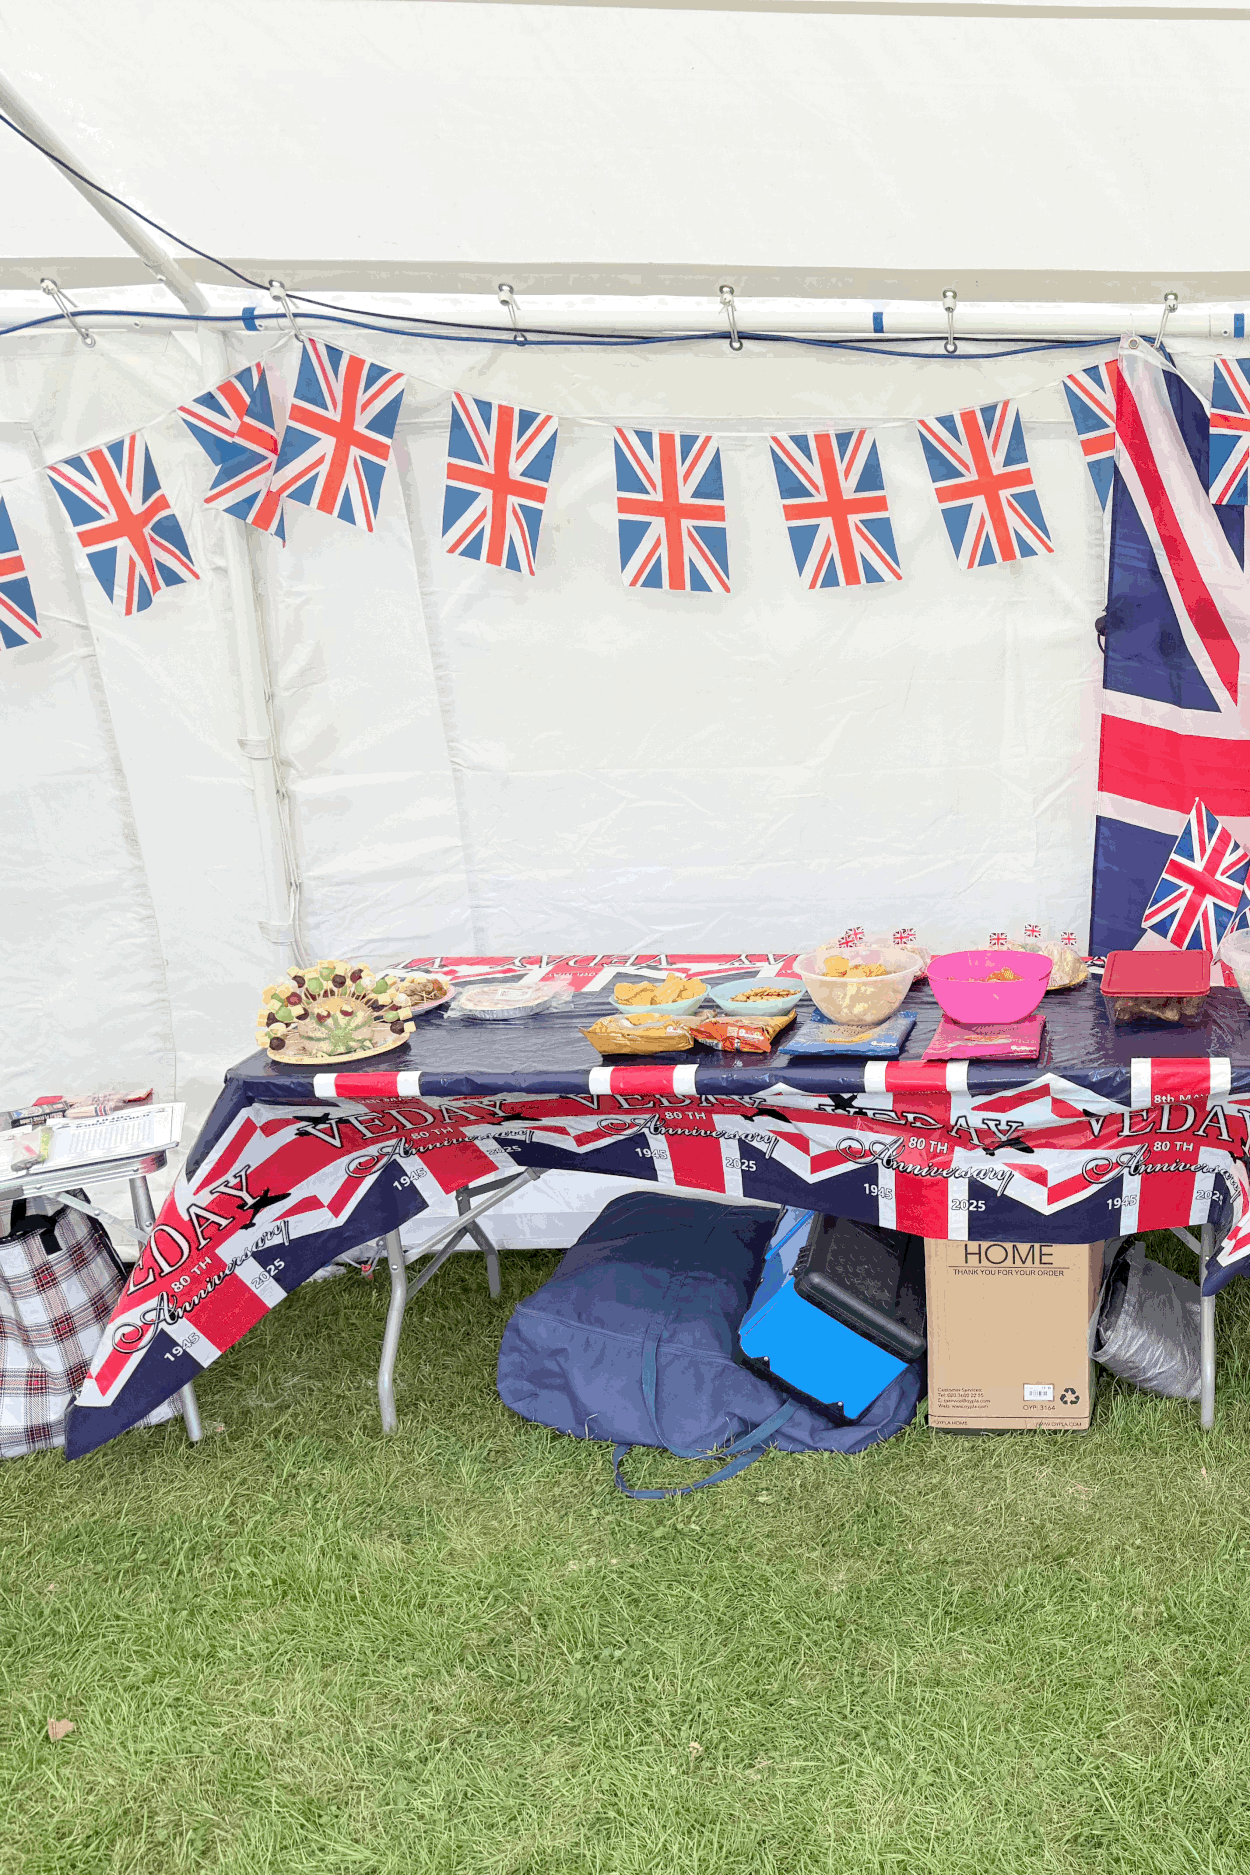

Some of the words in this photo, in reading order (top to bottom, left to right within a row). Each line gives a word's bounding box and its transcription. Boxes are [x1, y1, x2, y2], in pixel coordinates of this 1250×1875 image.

[1154, 1094, 1175, 1104] 8th
[299, 1098, 510, 1149] VEDAY
[665, 1111, 681, 1120] 80
[684, 1112, 706, 1120] TH
[411, 1131, 431, 1140] 80
[432, 1127, 454, 1137] TH
[597, 1113, 780, 1160] Anniversary
[908, 1136, 925, 1149] 80
[929, 1140, 949, 1154] TH
[345, 1130, 536, 1179] Anniversary
[1153, 1141, 1171, 1152] 80
[1174, 1141, 1194, 1152] TH
[635, 1147, 668, 1160] 1945
[725, 1157, 757, 1172] 2025
[836, 1136, 1015, 1198] Anniversary
[392, 1167, 428, 1191] 1945
[863, 1183, 893, 1200] 1945
[951, 1199, 986, 1212] 2025
[1106, 1194, 1138, 1210] 1945
[127, 1164, 261, 1296] EDAY
[964, 1243, 1054, 1266] HOME
[170, 1275, 191, 1293] 80
[190, 1256, 213, 1276] TH
[953, 1268, 978, 1276] THANK
[1015, 1269, 1036, 1277] YOUR
[1037, 1269, 1065, 1277] ORDER
[111, 1219, 290, 1354] Anniversary
[164, 1332, 200, 1362] 1945
[251, 1258, 286, 1290] 2025
